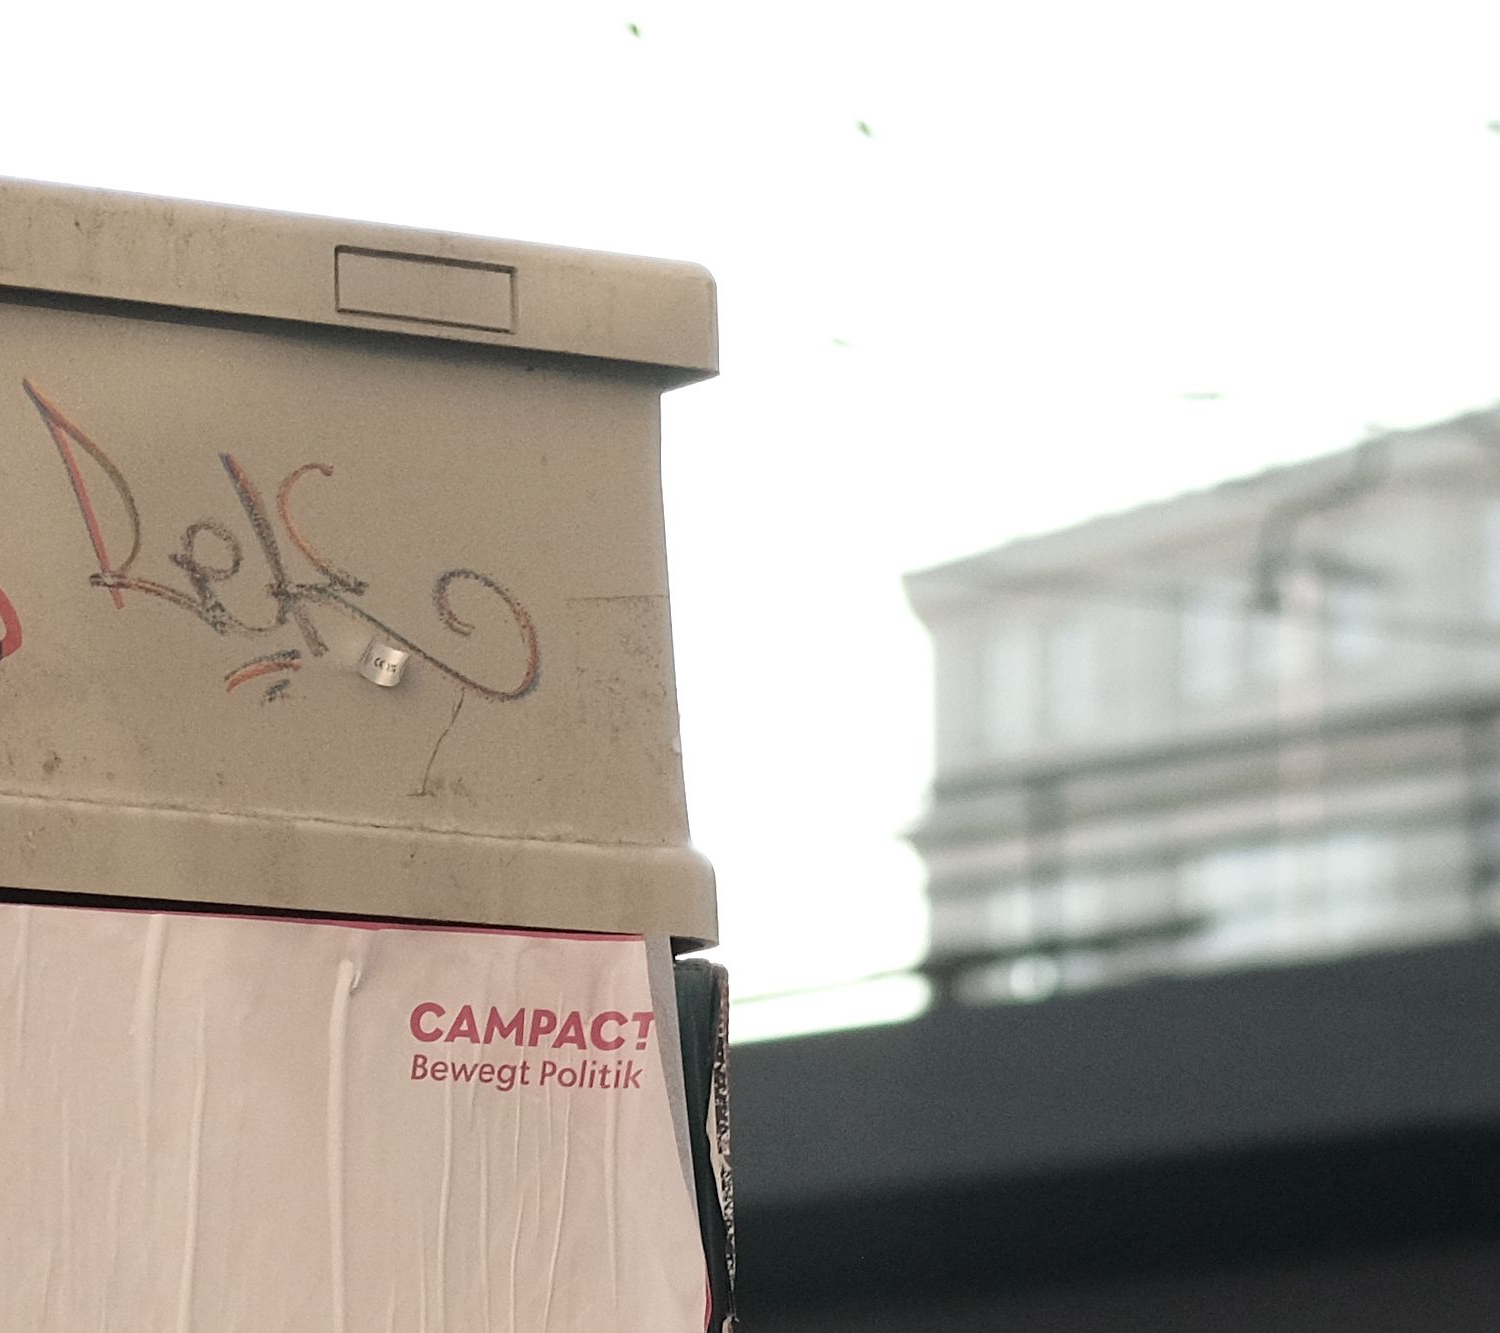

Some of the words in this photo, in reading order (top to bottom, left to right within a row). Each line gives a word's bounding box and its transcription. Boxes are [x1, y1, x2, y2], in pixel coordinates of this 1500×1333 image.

[409, 1001, 656, 1051] CAMPACT
[410, 1053, 531, 1092] Bewegt
[538, 1057, 645, 1090] Politik
